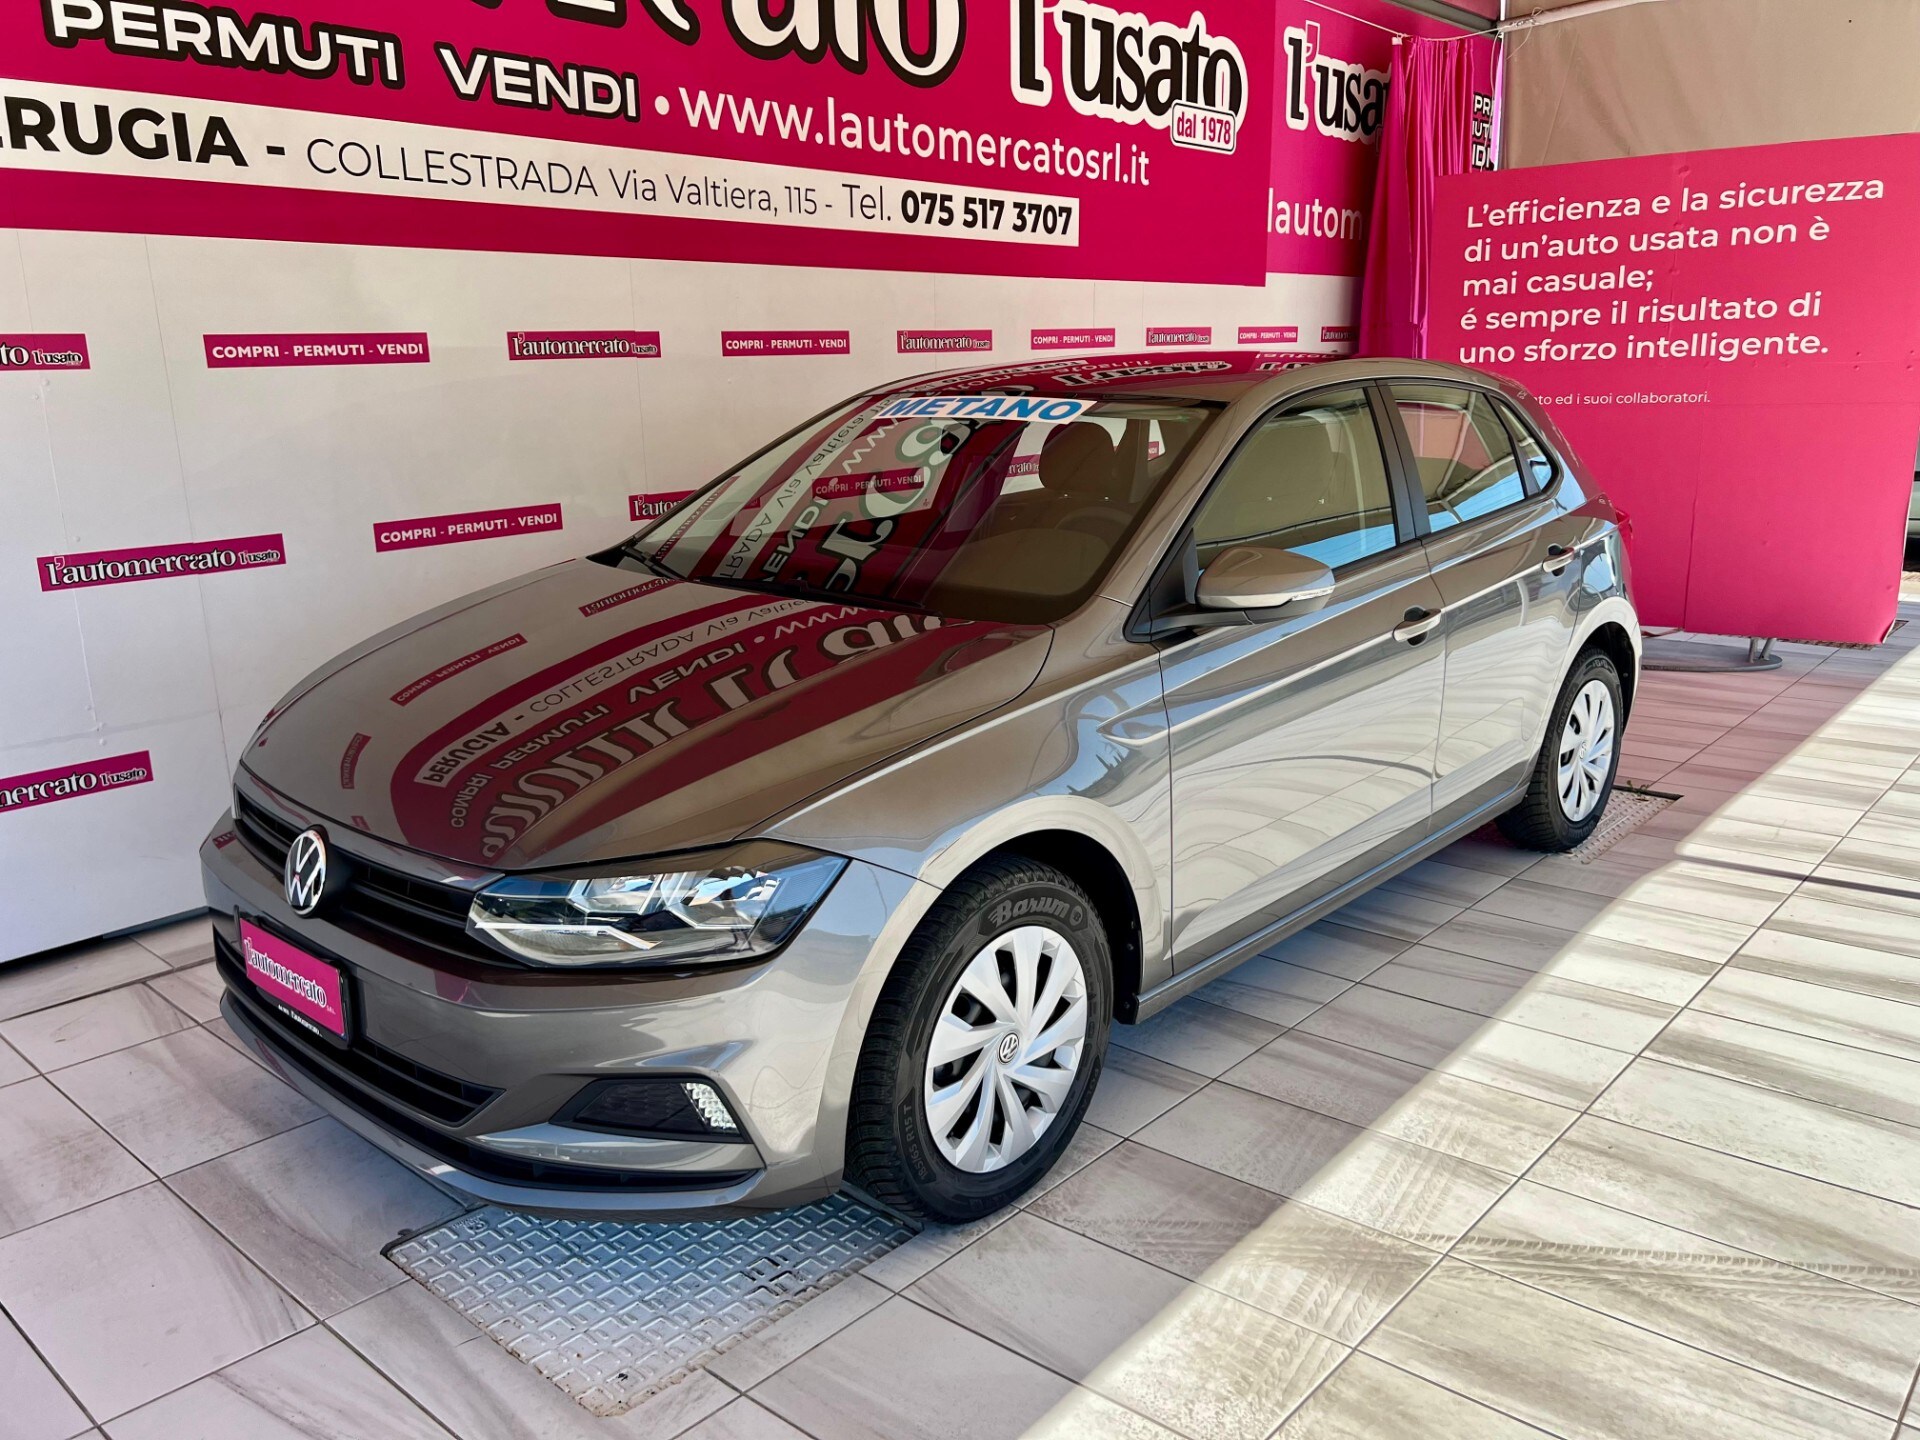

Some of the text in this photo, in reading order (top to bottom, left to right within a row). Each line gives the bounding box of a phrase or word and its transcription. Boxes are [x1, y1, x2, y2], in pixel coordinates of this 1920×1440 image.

[51, 0, 1150, 187] PERMUTI VENDI www.lautomercatosrl.it
[1288, 19, 1389, 136] l'usa
[1176, 111, 1232, 146] dal 1978
[0, 96, 249, 167] RUGIA
[307, 138, 598, 197] COLLESTRADA
[608, 168, 657, 202] Via
[665, 173, 778, 217] Valtiera,
[784, 185, 818, 215] 115
[842, 183, 892, 222] Tel.
[900, 189, 954, 225] 075
[962, 196, 1005, 231] 517
[1012, 201, 1073, 236] 3707
[1651, 195, 1672, 214] e
[1681, 187, 1709, 213] la
[1718, 179, 1885, 210] sicurezza
[1463, 237, 1492, 263] di
[1629, 226, 1719, 252] usata
[1730, 222, 1798, 247] non
[1808, 215, 1831, 242] è
[1462, 264, 1654, 297] mai casuale;
[1460, 290, 1822, 333] é sempre il risultato di
[212, 345, 280, 359] COMPRI
[293, 344, 366, 357] PERMUTI
[376, 343, 424, 355] VENDI
[512, 332, 630, 356] l'automercato
[725, 340, 764, 350] COMPRI
[771, 339, 813, 349] PERMUTI
[819, 338, 847, 348] VENDI
[901, 331, 972, 350] l'automercato
[1033, 336, 1059, 344] COMPRI
[1063, 335, 1091, 344] PERMUTI
[1095, 334, 1113, 343] VENDI
[1459, 331, 1830, 364] uno sforzo intelligente.
[886, 397, 1083, 421] METANO
[1555, 393, 1573, 405] ed
[1583, 392, 1613, 405] suoi
[1615, 390, 1711, 405] collaboratori.
[816, 481, 849, 495] COMPRI
[380, 526, 437, 544] COMPRI
[448, 519, 509, 536] PERMUTI
[518, 512, 558, 527] VENDI
[990, 896, 1071, 928] Barum
